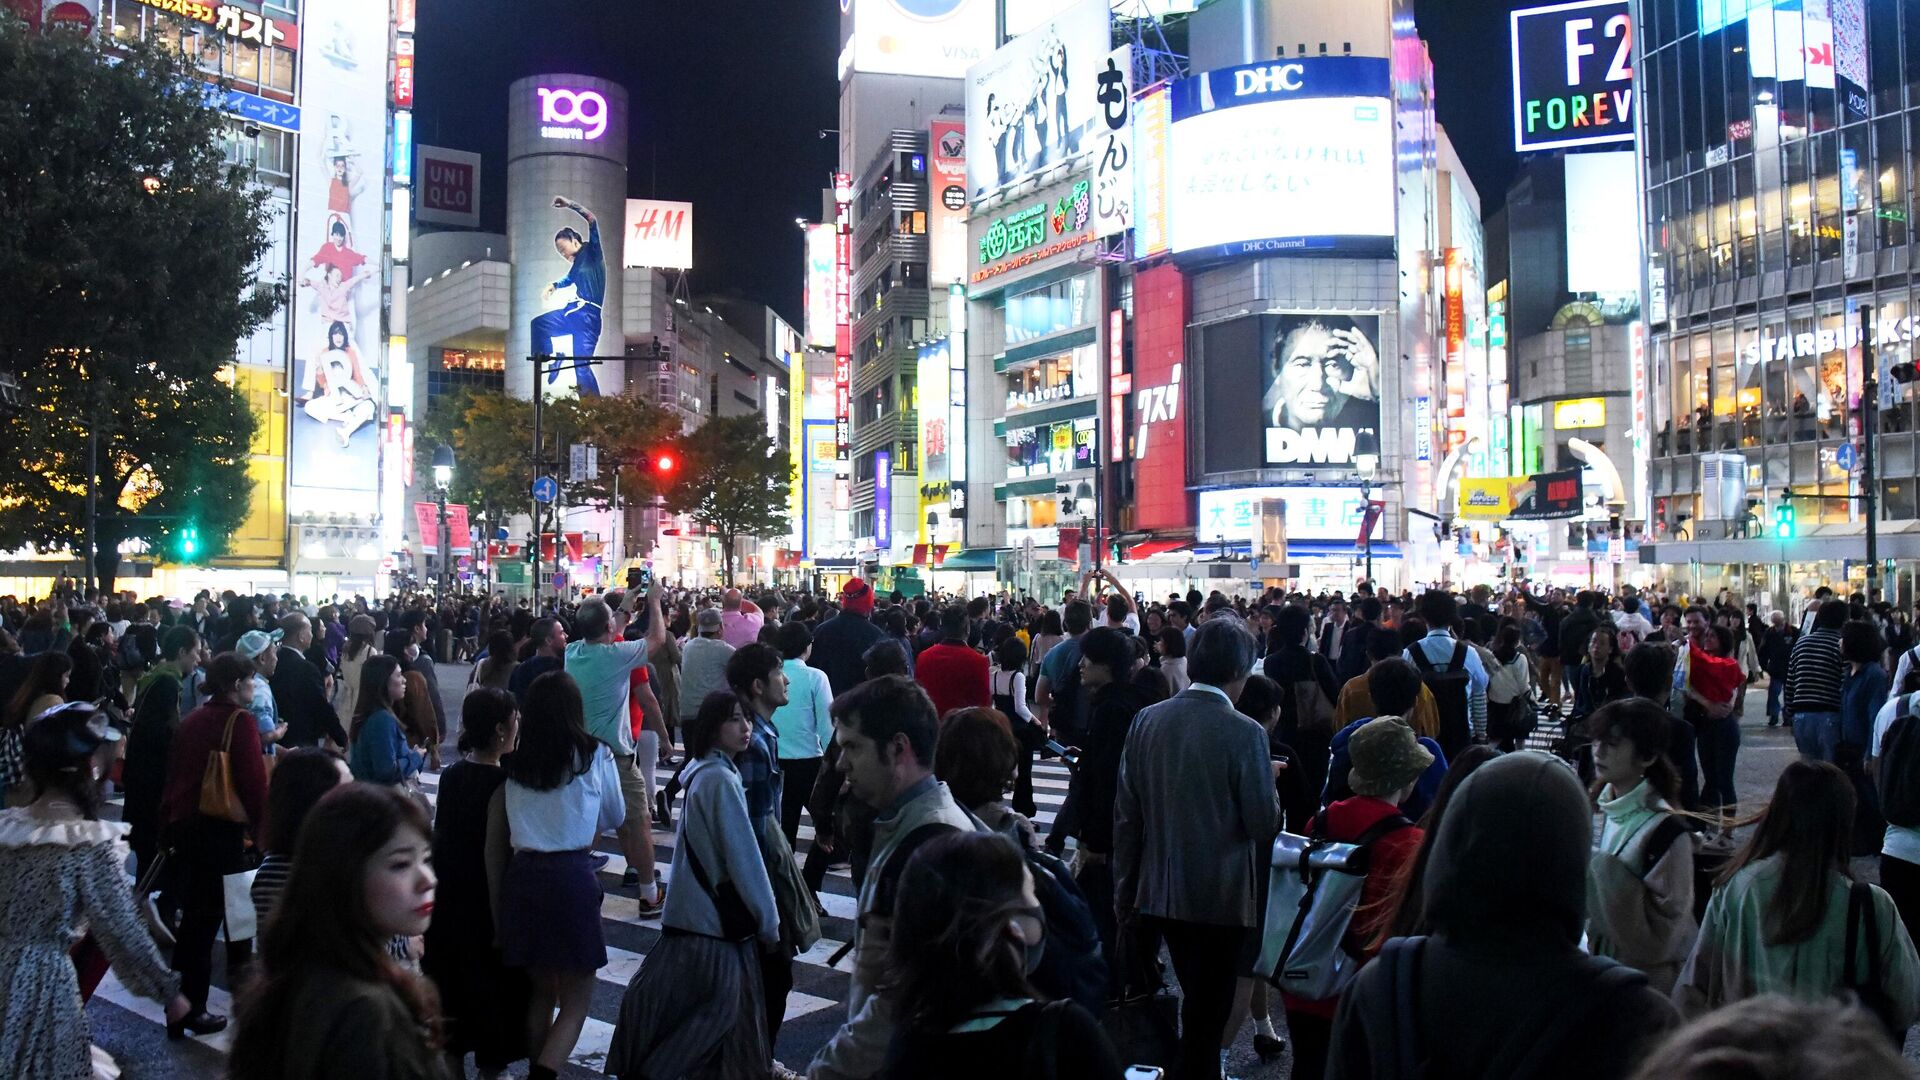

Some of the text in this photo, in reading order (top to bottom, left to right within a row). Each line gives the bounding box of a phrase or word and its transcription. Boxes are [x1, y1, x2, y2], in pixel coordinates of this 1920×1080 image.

[216, 5, 285, 47] ガスト
[943, 45, 981, 60] VISA
[1235, 64, 1303, 96] DHC
[538, 88, 607, 140] 109
[1527, 89, 1632, 133] FOREV
[541, 126, 583, 140] SHIBUYA
[1096, 56, 1130, 227] もんじゃ
[429, 165, 465, 187] UNI
[429, 186, 467, 207] QLO
[634, 208, 684, 241] H&M
[1007, 216, 1046, 253] 西村
[1243, 238, 1305, 251] DHC Channel
[1209, 497, 1364, 529] 大盛書店
